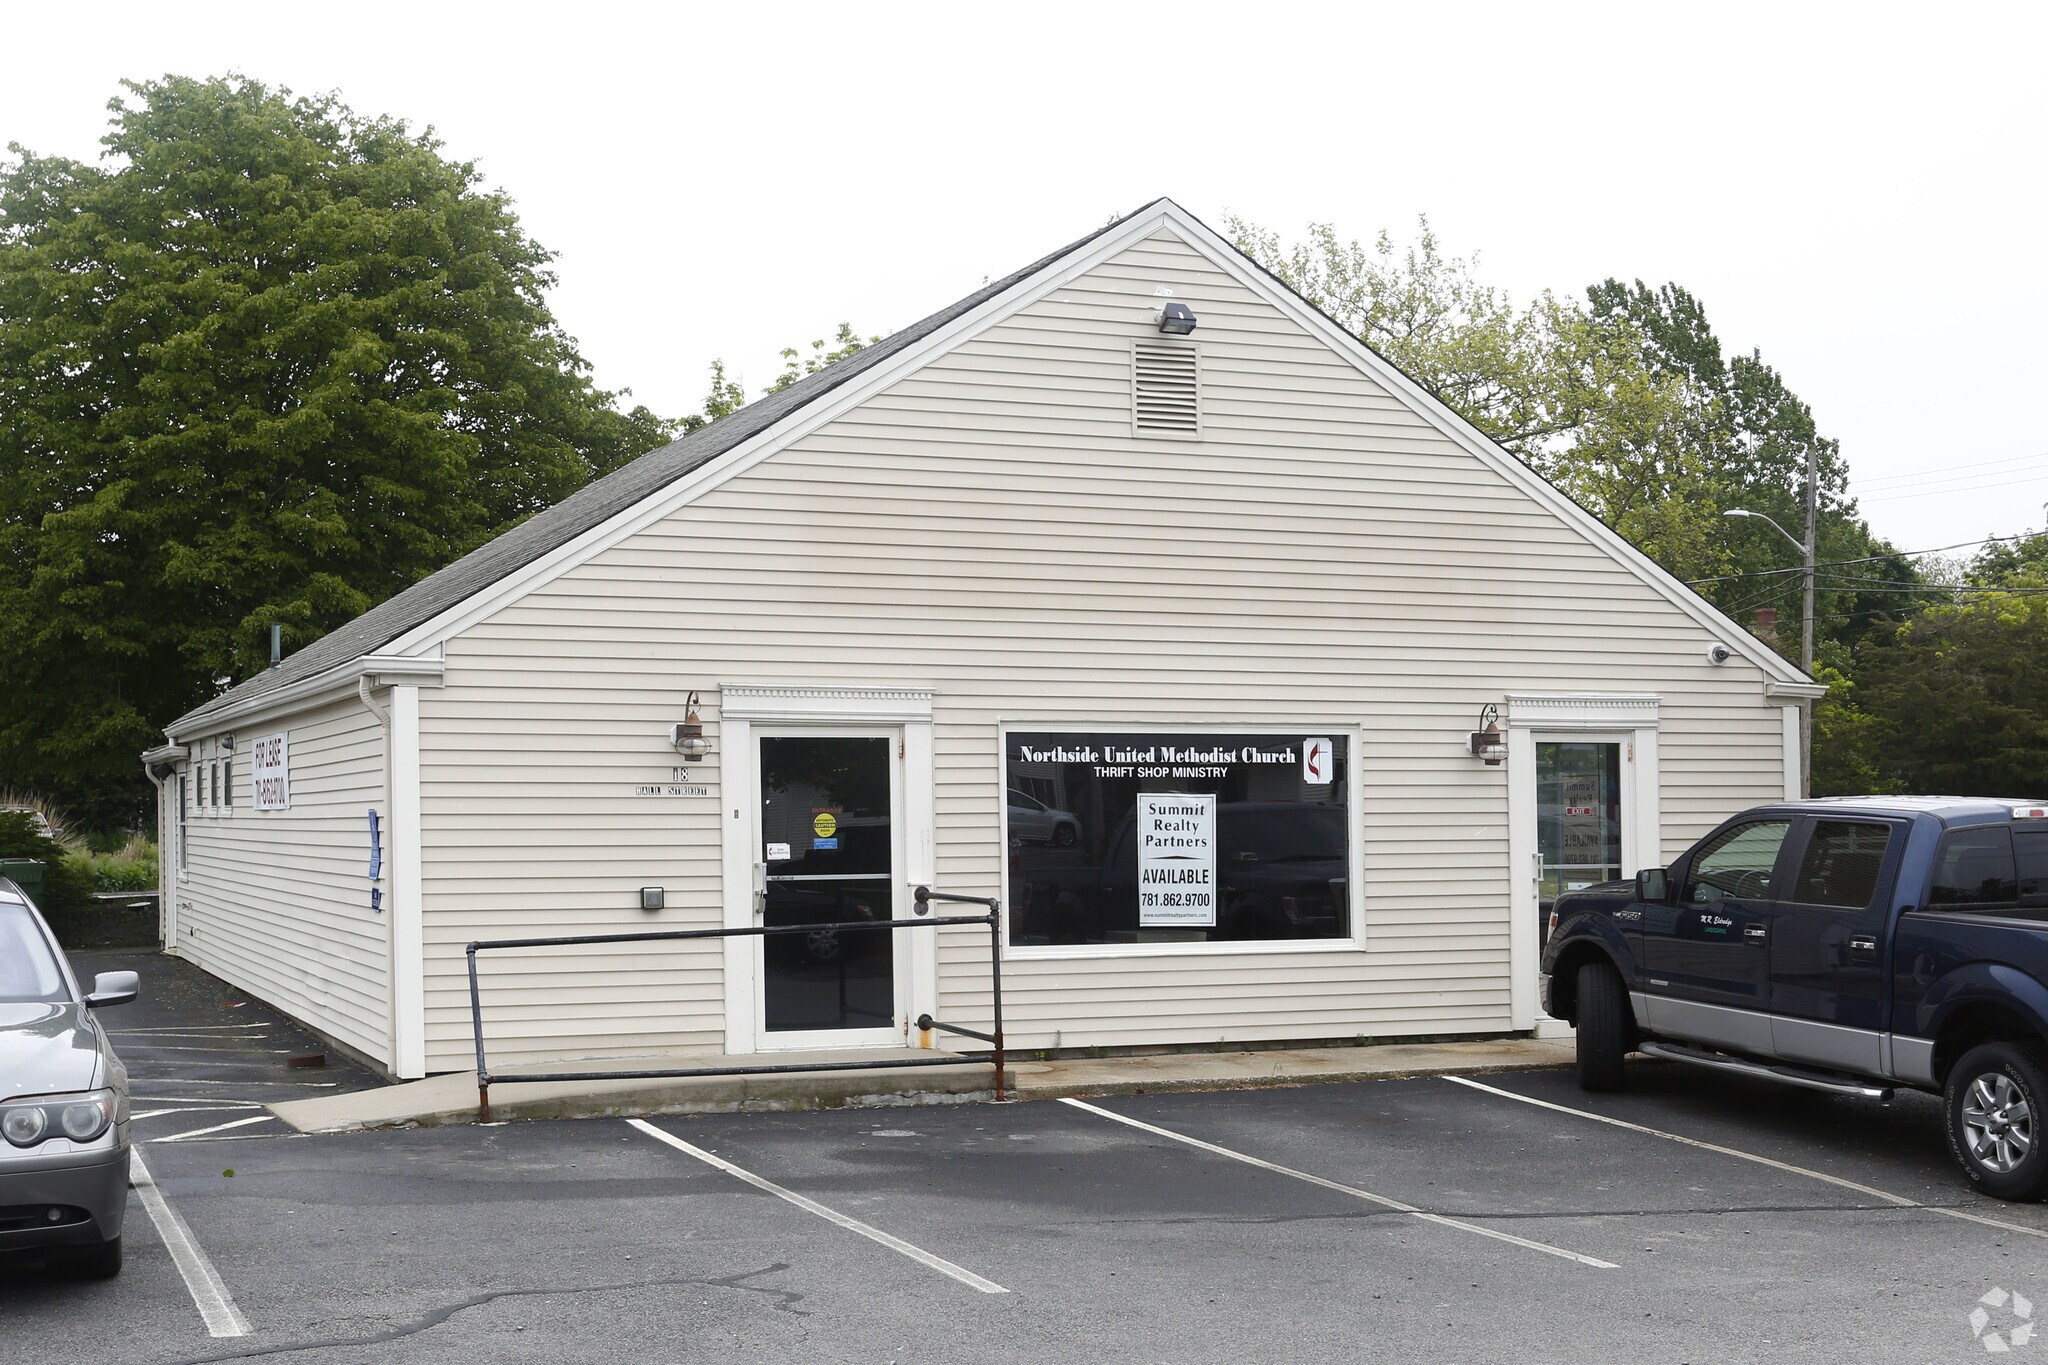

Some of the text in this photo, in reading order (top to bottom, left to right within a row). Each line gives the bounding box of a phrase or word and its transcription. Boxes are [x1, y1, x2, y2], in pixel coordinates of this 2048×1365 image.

[256, 738, 281, 769] FOR LEASE
[1020, 746, 1296, 764] Northside United Methodist Church
[673, 767, 688, 781] 18
[1094, 766, 1228, 778] THRIFT SHOP MINISTRY
[636, 786, 707, 795] HALL STREET
[1149, 803, 1205, 816] Summit
[1154, 819, 1199, 835] Realty
[1146, 835, 1207, 847] Partners
[1142, 869, 1209, 884] AVAILABLE
[1141, 893, 1210, 906] 781.862.9700
